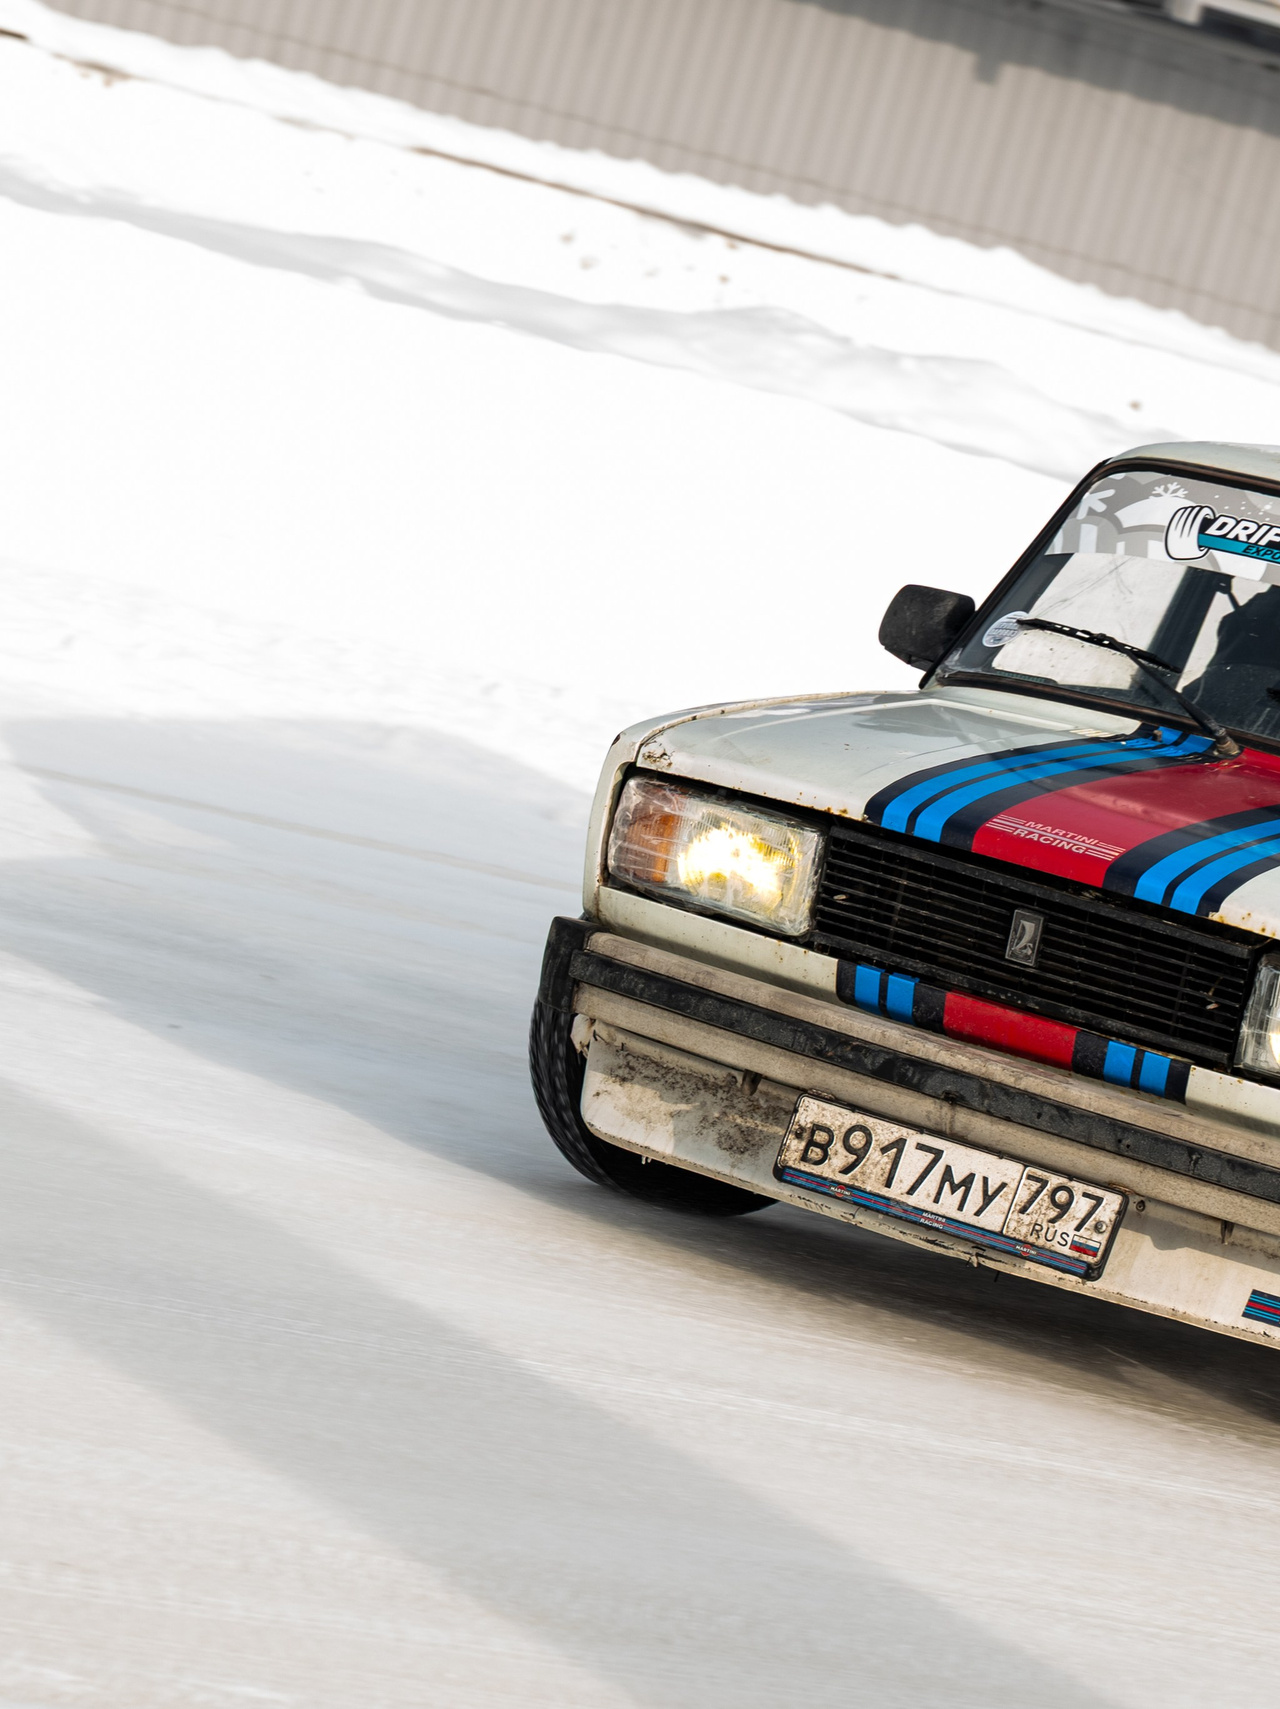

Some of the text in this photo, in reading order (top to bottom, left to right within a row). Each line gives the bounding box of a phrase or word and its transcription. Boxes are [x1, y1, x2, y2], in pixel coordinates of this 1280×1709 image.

[1013, 828, 1089, 854] RACING
[1024, 821, 1099, 846] MARTINI
[830, 1186, 851, 1196] MARTINI
[1018, 1174, 1105, 1233] 797
[919, 1217, 944, 1230] RACING
[1029, 1222, 1070, 1247] RUS
[1015, 1244, 1037, 1256] MARTINI
